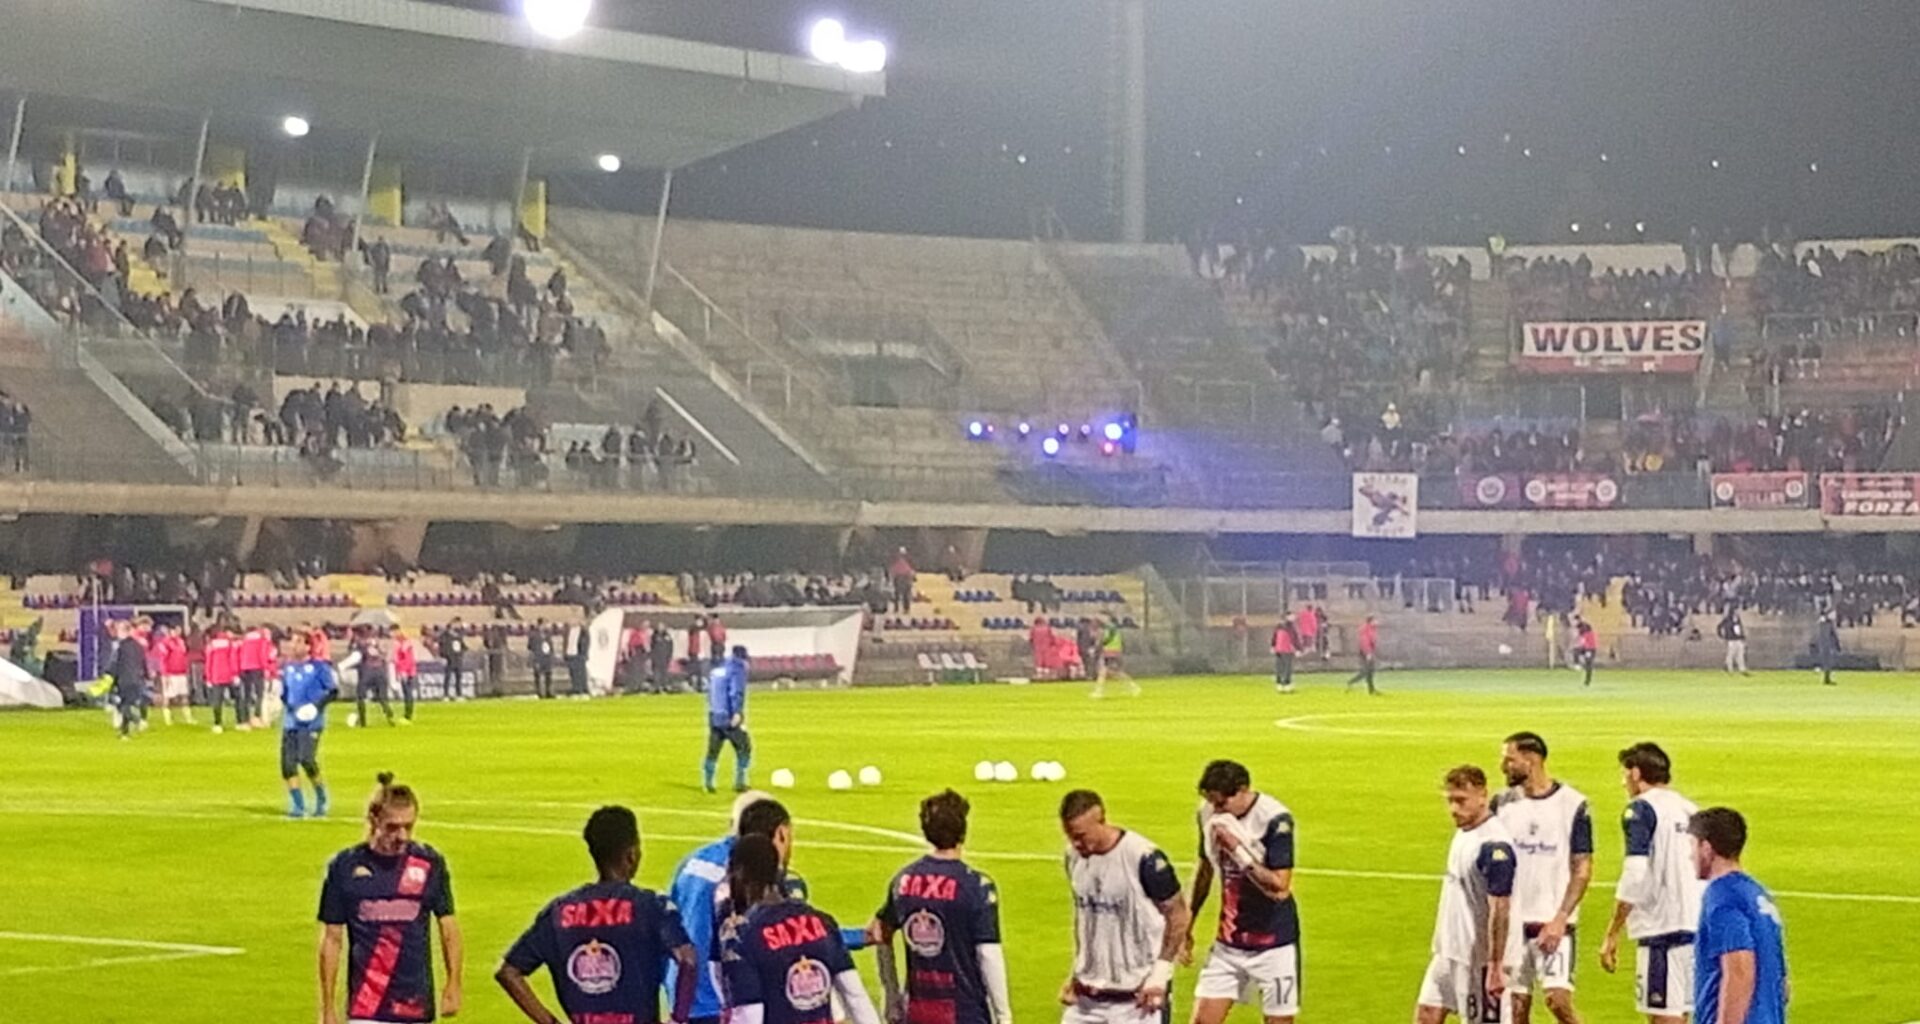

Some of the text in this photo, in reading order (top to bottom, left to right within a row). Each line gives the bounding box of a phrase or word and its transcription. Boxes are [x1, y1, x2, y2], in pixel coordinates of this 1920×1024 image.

[1531, 324, 1702, 353] WOLVES
[1843, 501, 1920, 514] FORZA
[899, 874, 957, 901] SAXA
[560, 898, 633, 928] SAXA
[762, 915, 828, 951] SAXA
[1543, 951, 1564, 976] 21
[1274, 975, 1294, 1006] 17
